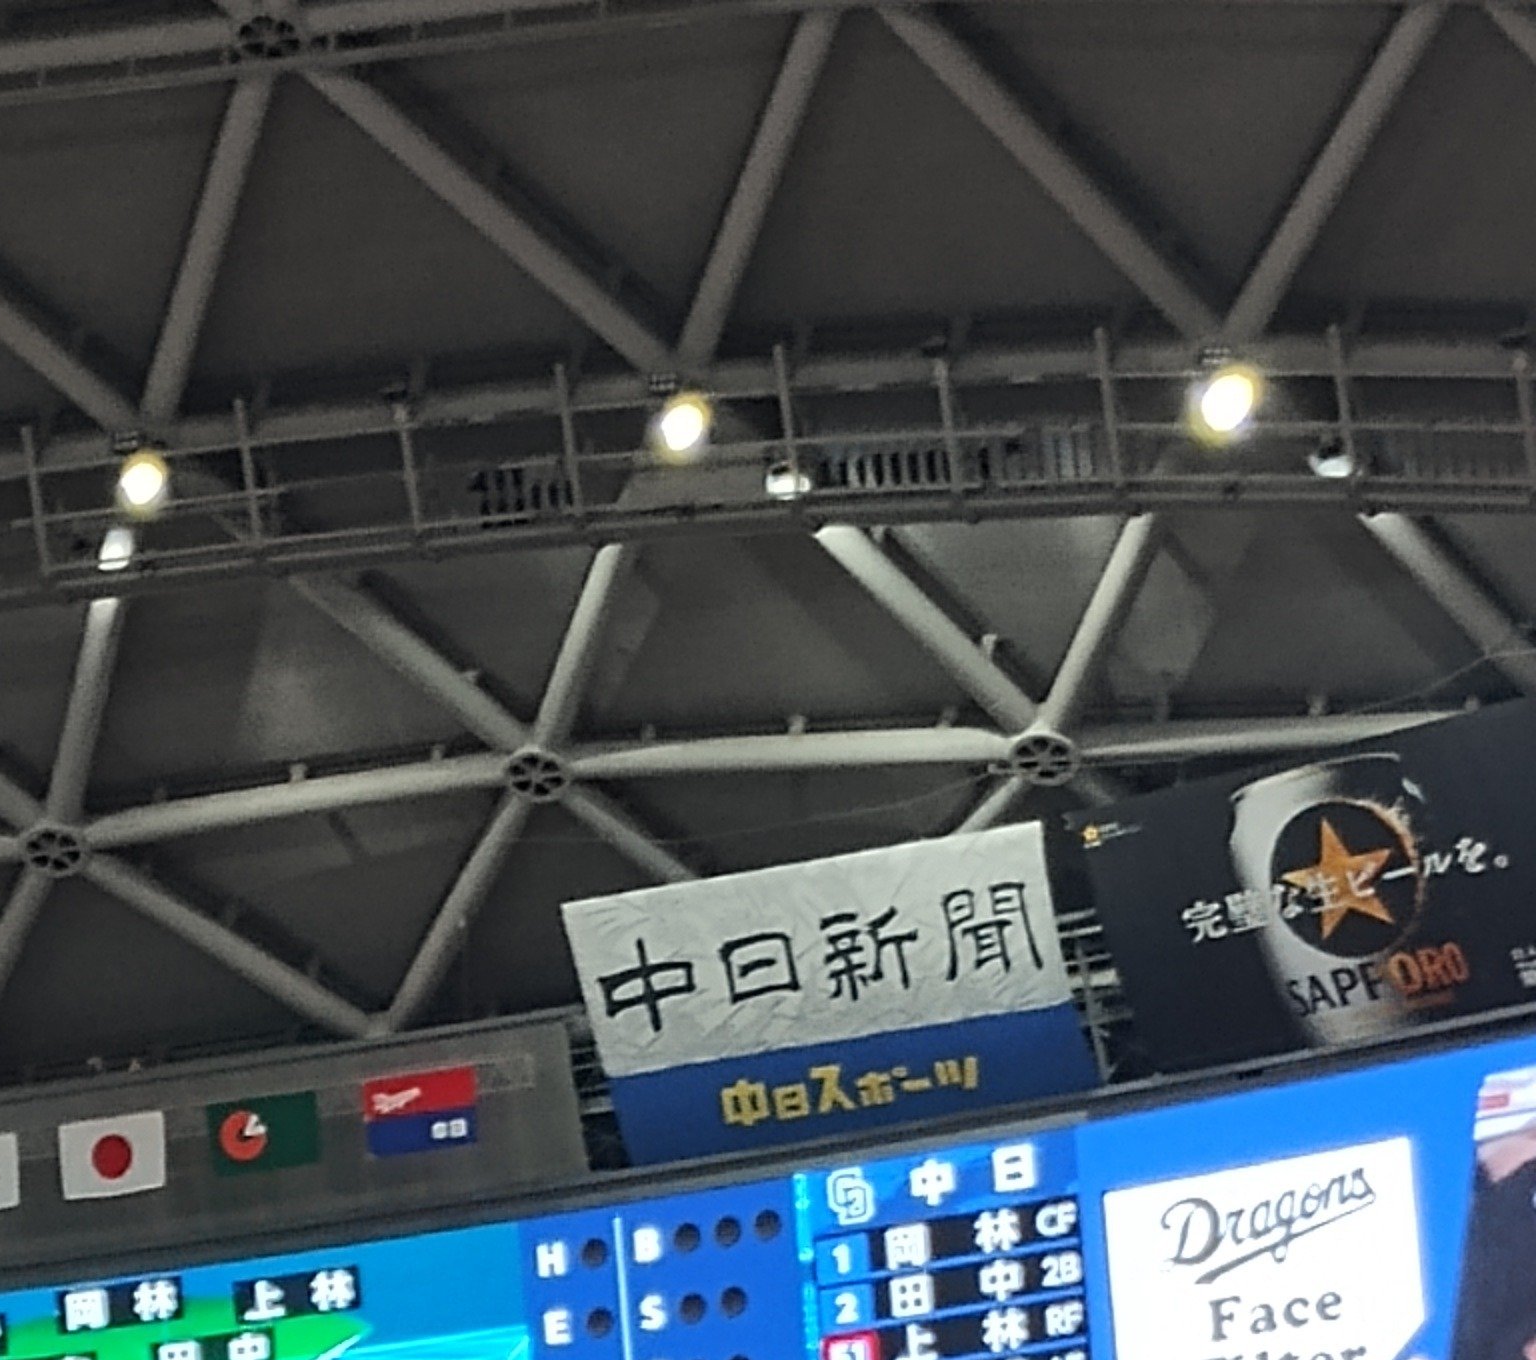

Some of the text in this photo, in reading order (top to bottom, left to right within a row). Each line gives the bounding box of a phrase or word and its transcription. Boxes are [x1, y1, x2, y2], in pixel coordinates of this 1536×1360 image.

[597, 880, 1044, 1033] 中日新聞
[720, 1055, 980, 1127] 中日スポーツ
[909, 1142, 1036, 1206] 中日
[633, 1226, 662, 1263] B
[832, 1201, 1078, 1274] 1 岡林 CF
[1161, 1167, 1376, 1285] Dragons
[536, 1240, 567, 1277] H
[64, 1280, 178, 1331] 岡林
[243, 1268, 357, 1322] 上林
[639, 1294, 666, 1330] S
[835, 1250, 1083, 1324] 2 田中 2B
[543, 1309, 572, 1345] E
[1045, 1300, 1084, 1337] RF
[1209, 1290, 1342, 1342] Face
